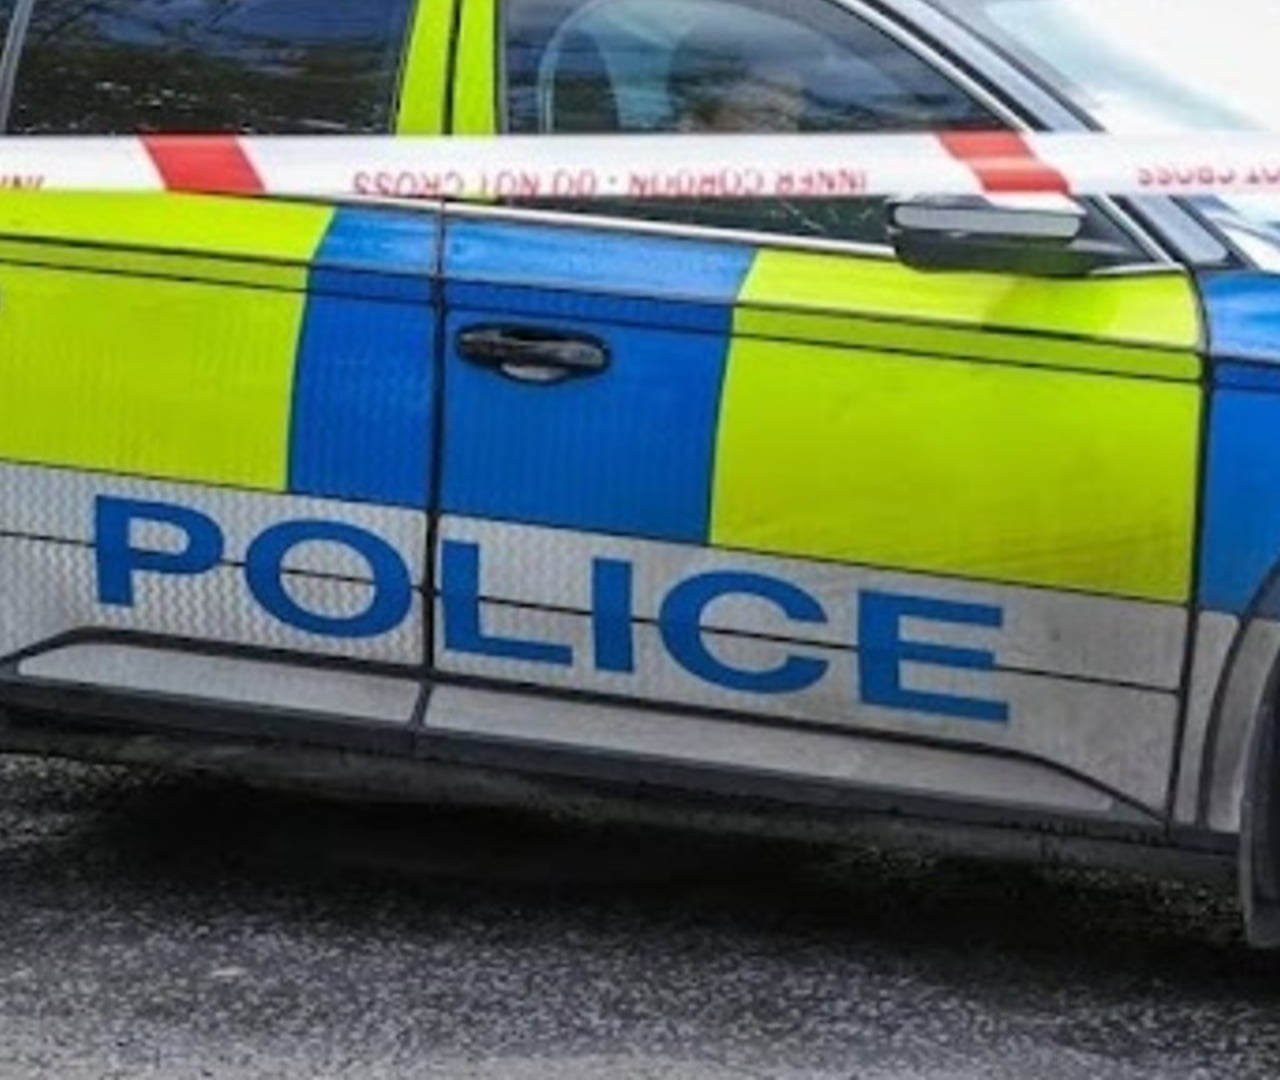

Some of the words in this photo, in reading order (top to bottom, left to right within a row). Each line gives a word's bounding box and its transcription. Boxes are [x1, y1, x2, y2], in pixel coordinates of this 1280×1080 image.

[352, 171, 464, 198] CROSS
[552, 170, 596, 197] DO
[629, 169, 764, 198] CORDON
[776, 168, 866, 197] INNER
[94, 494, 1010, 723] POLICE
